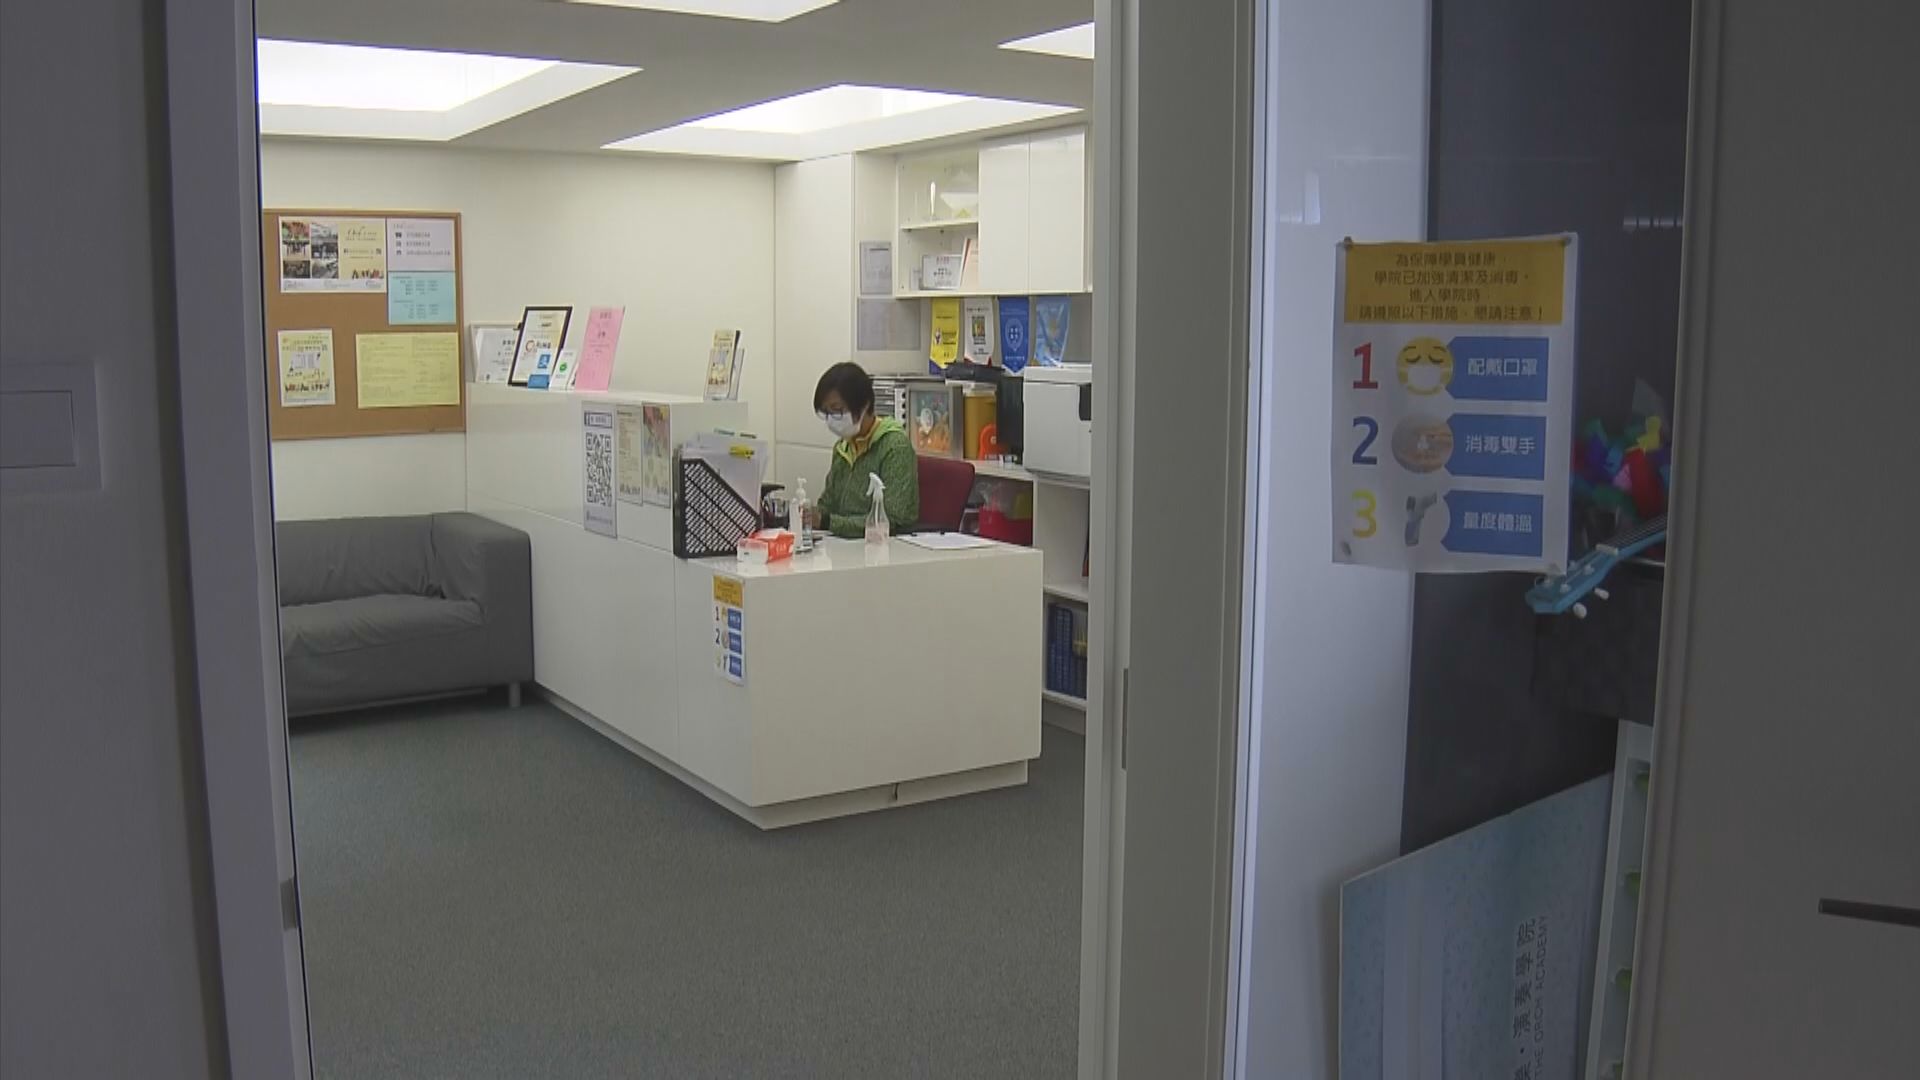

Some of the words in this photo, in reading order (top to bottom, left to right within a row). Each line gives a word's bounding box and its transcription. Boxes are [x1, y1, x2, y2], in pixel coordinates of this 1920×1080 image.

[1352, 342, 1379, 390] 1
[1467, 357, 1538, 377] 配戴口罩
[1352, 416, 1379, 465] 2
[1464, 435, 1536, 455] 消毒雙手
[1352, 489, 1377, 538] 3
[1535, 915, 1548, 991] ACADEMY
[1534, 997, 1545, 1042] ORCH
[1534, 1047, 1545, 1079] THE
